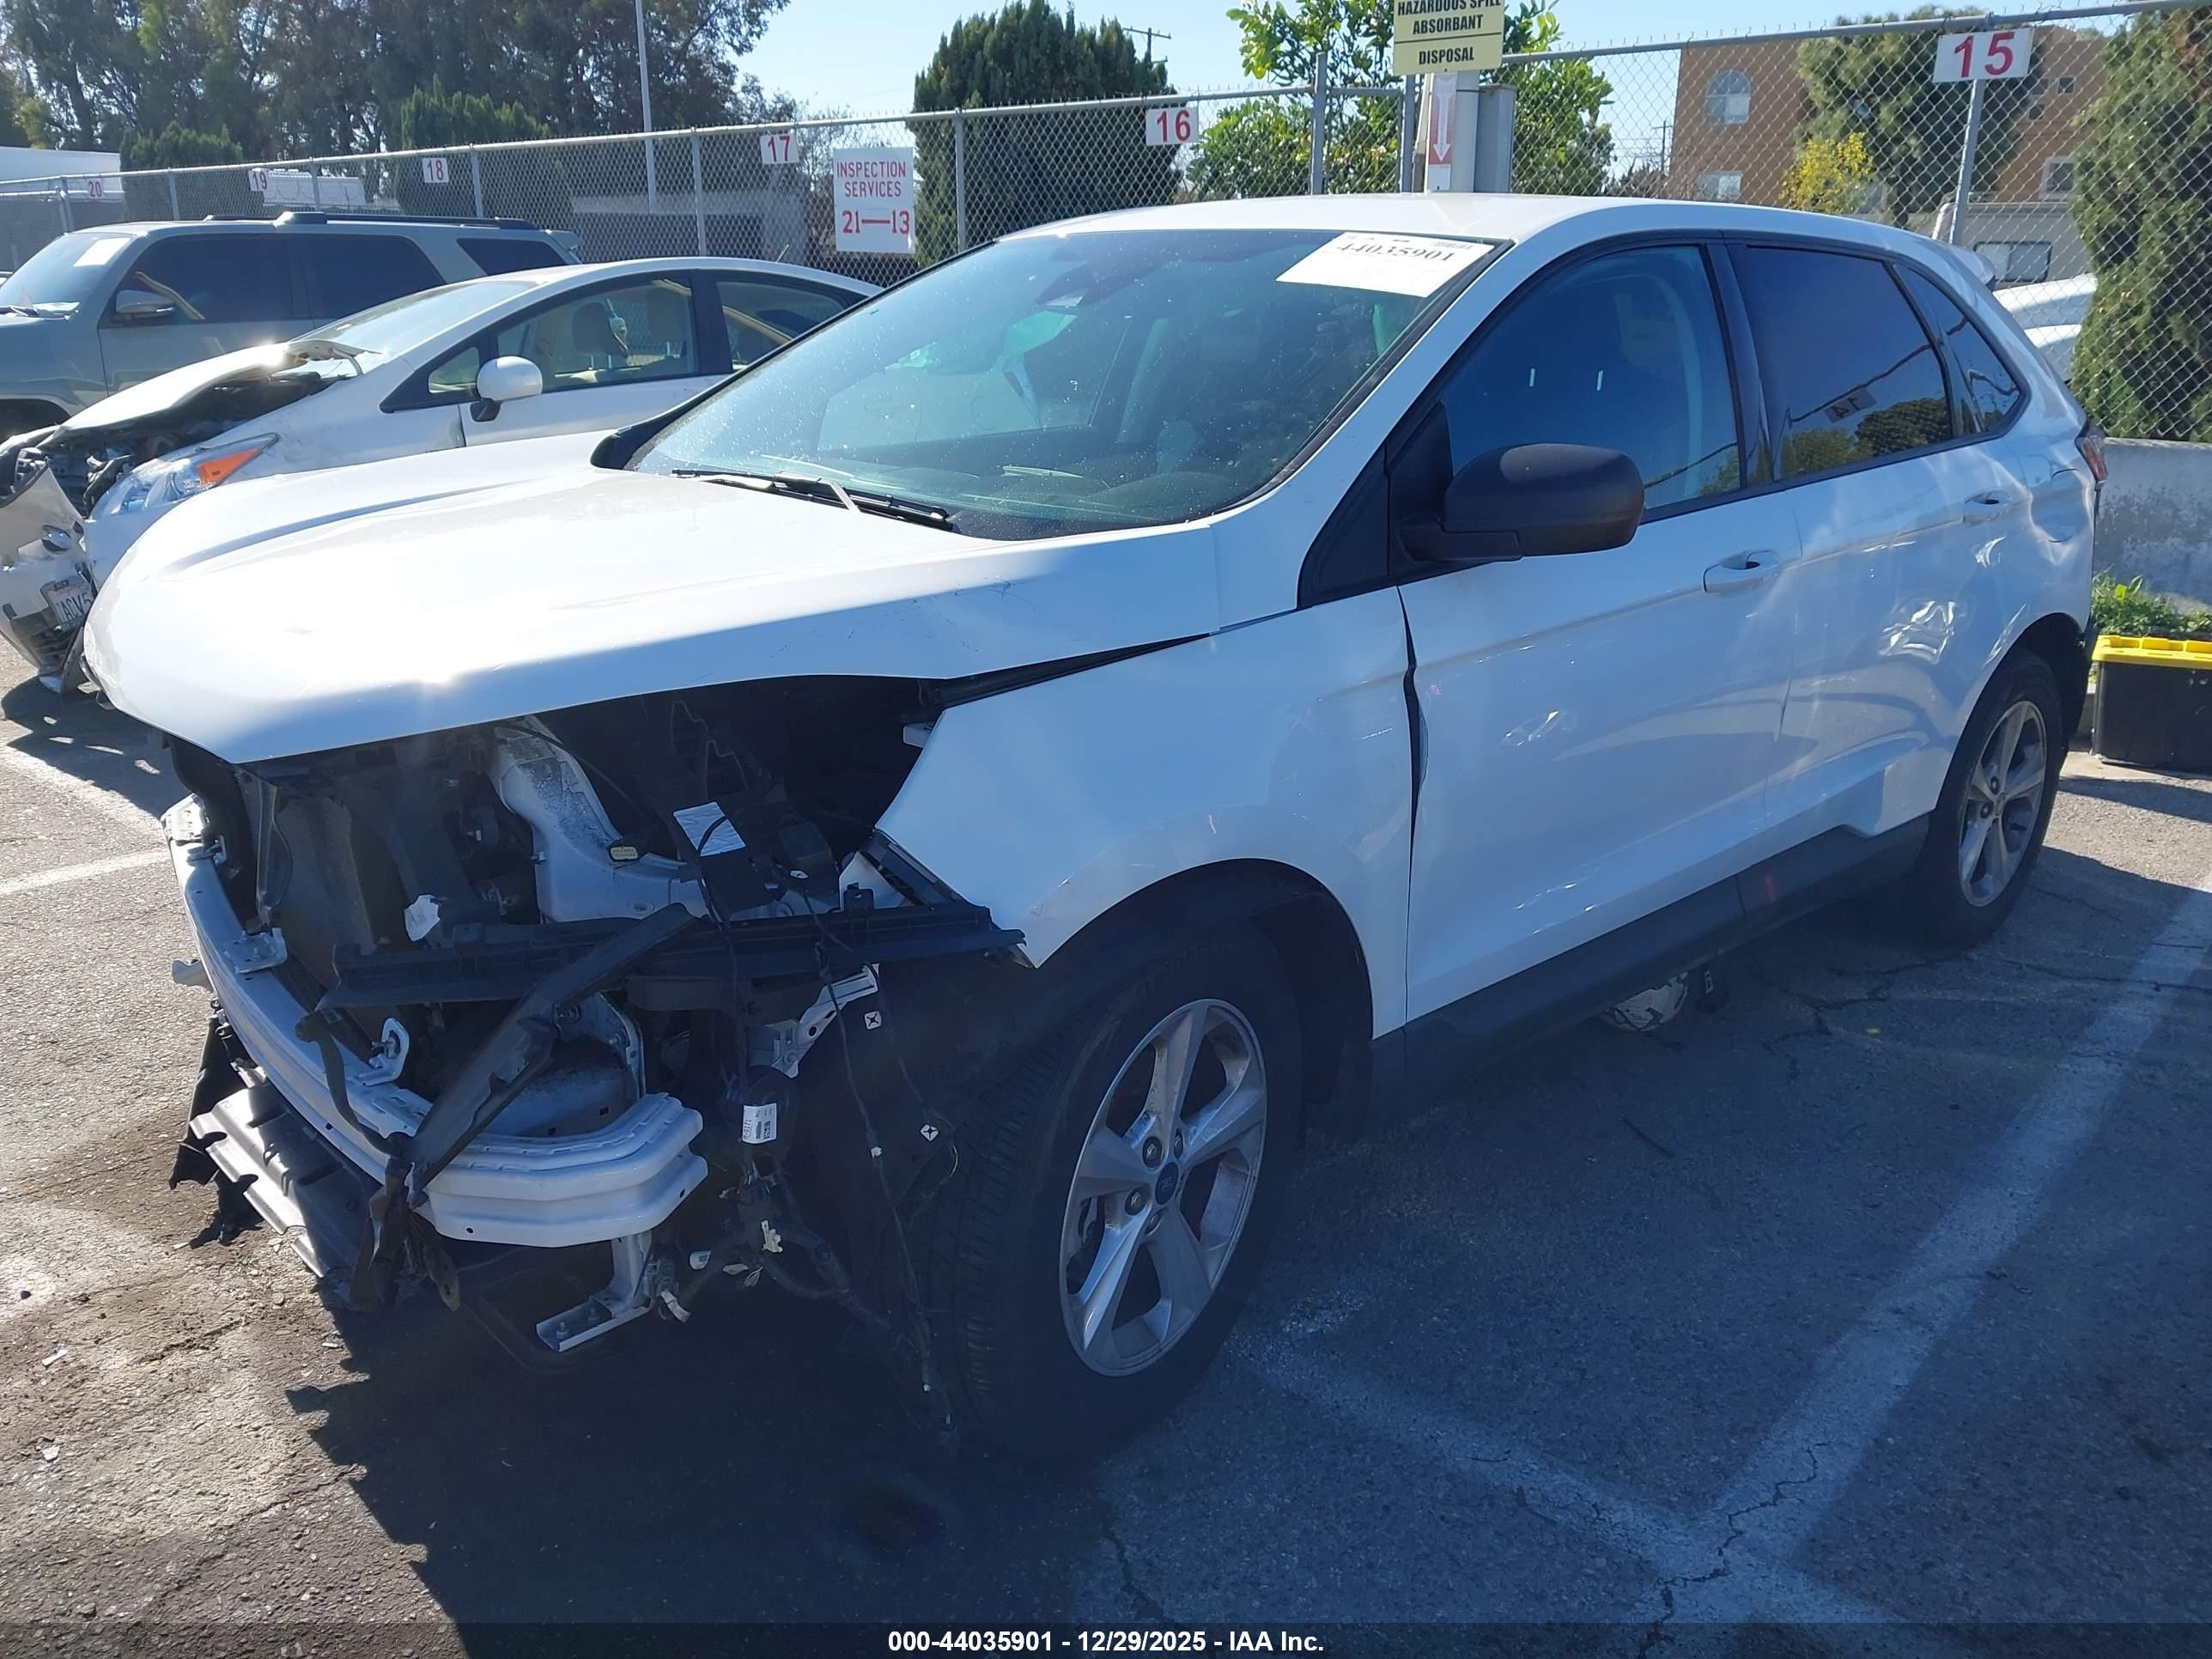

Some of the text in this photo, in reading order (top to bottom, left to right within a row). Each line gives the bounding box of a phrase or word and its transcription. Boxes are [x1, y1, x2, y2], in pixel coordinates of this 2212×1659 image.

[1398, 0, 1467, 15] HAZARDOUS
[1413, 15, 1484, 34] ABSORBANT
[1419, 46, 1474, 64] DISPOSAL
[1954, 31, 2015, 77] 15
[1157, 109, 1191, 143] 16
[768, 136, 790, 162] 17
[427, 160, 444, 181] 18
[837, 161, 906, 178] INSPECTION
[88, 180, 102, 198] 20
[252, 171, 267, 190] 19
[844, 181, 902, 198] SERVICES
